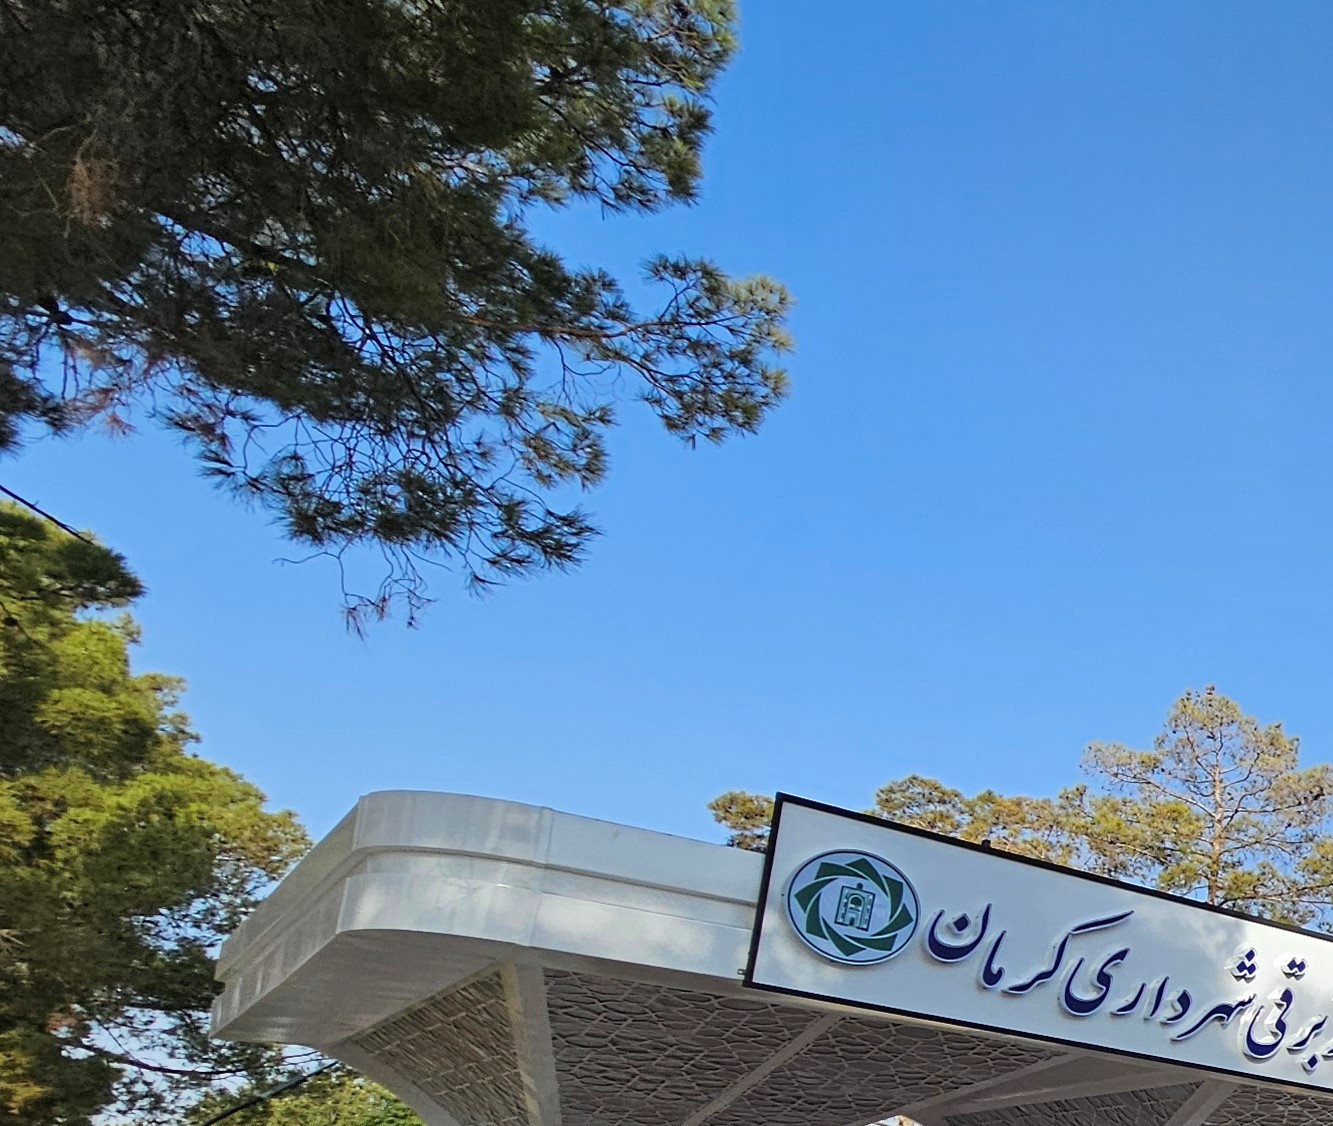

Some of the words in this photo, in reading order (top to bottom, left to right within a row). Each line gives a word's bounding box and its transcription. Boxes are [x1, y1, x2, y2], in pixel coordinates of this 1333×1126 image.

[926, 902, 1136, 994] کرمان
[1060, 947, 1258, 1042] شهرداری
[1244, 955, 1330, 1072] برقی
